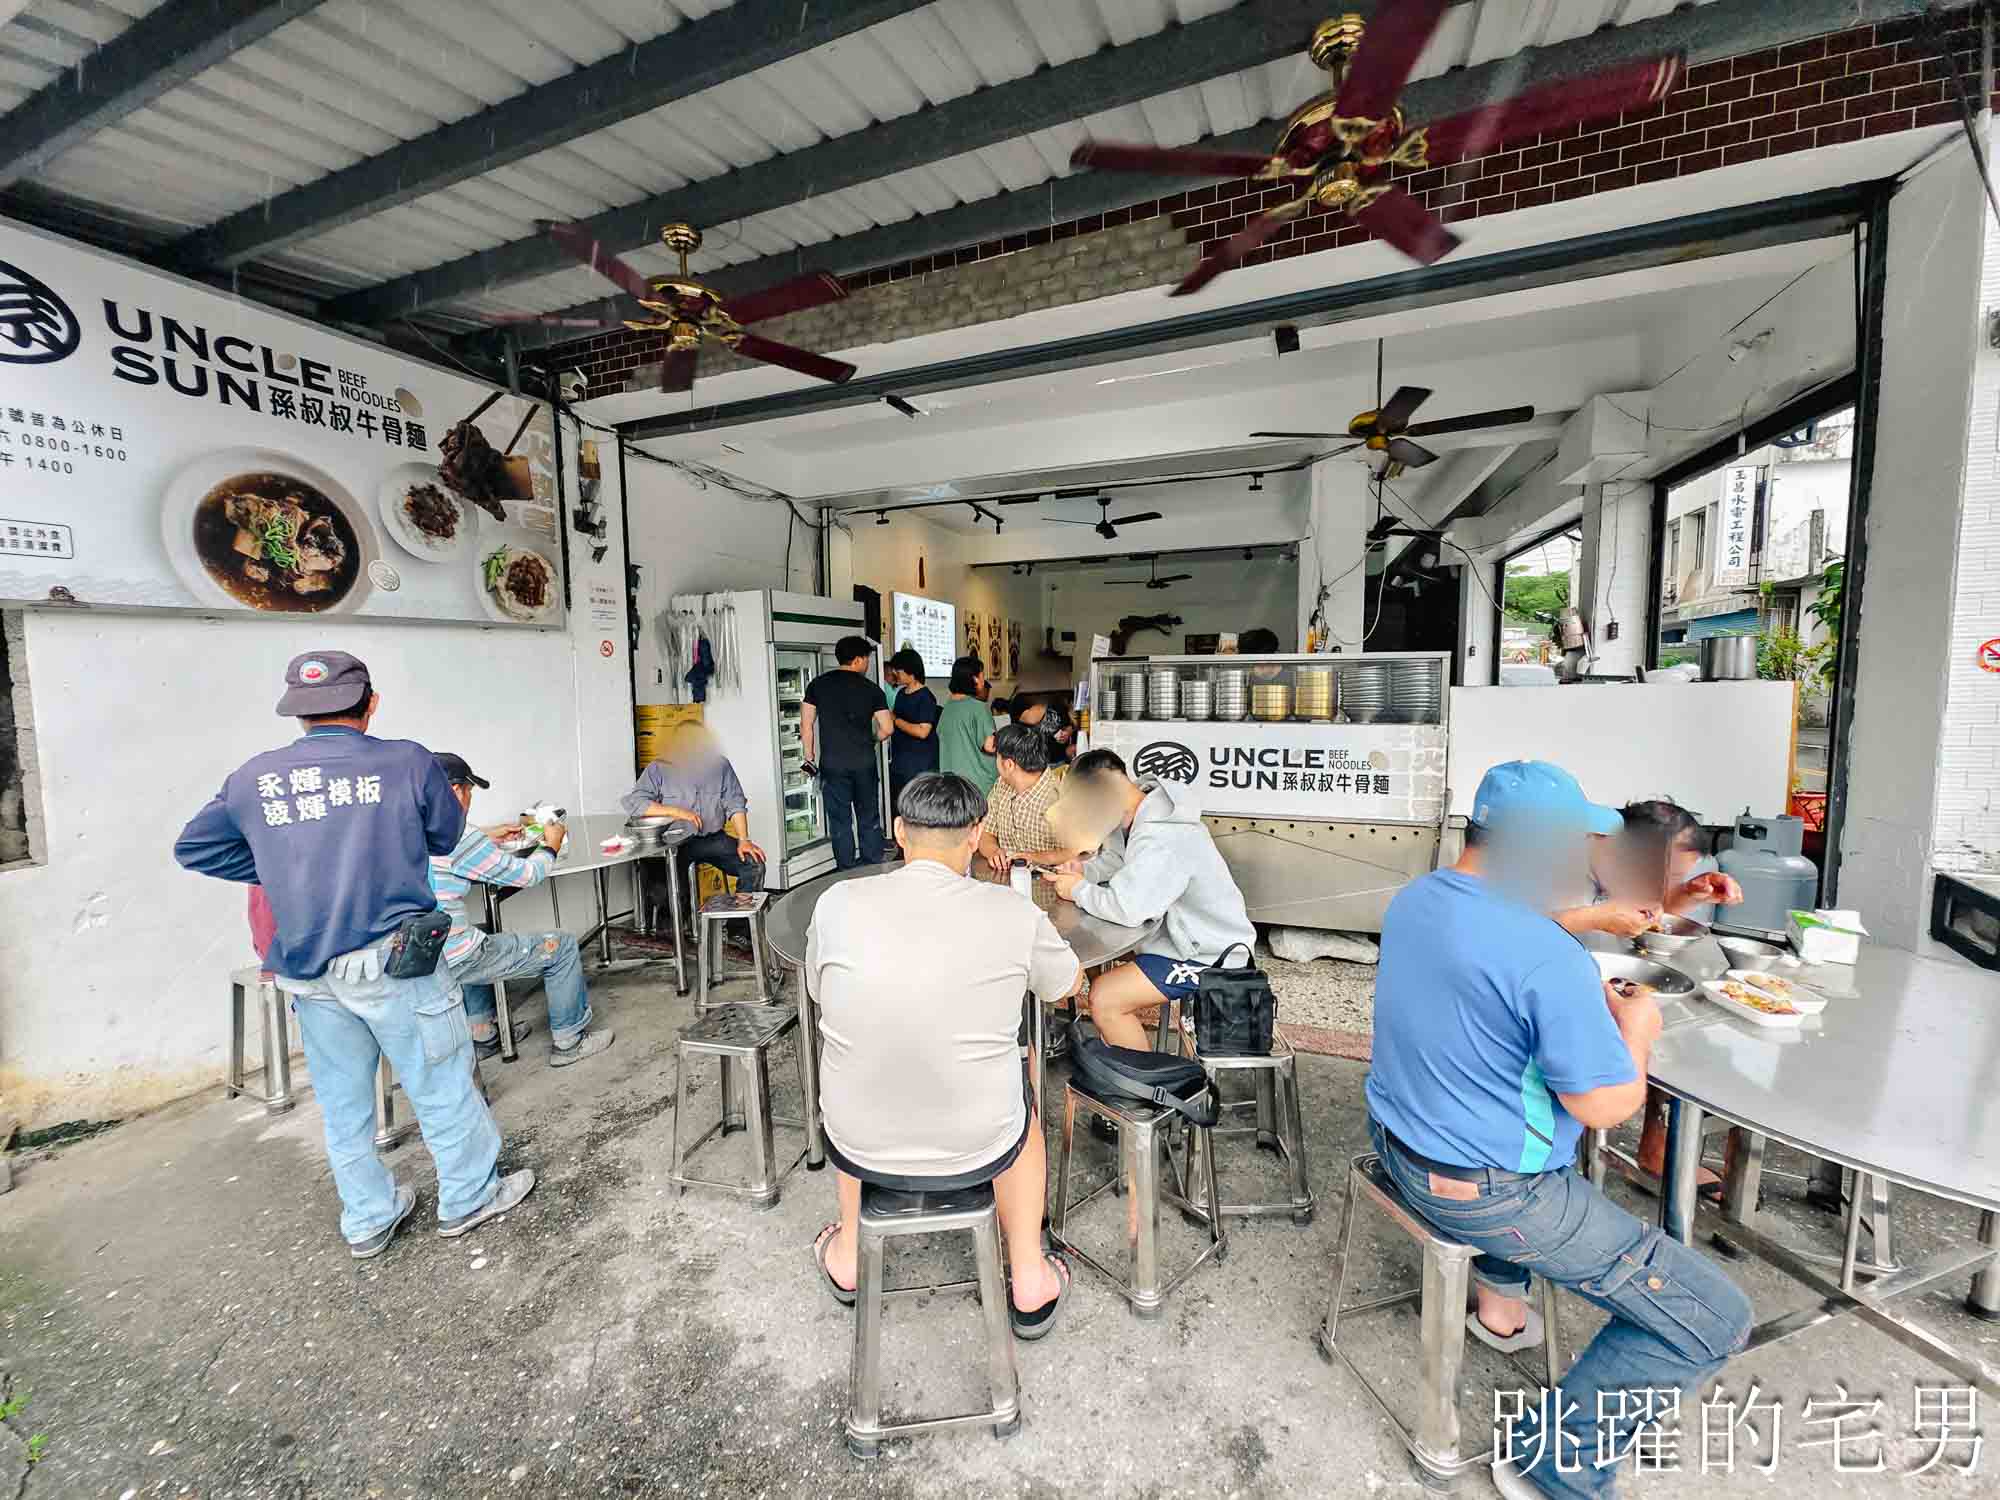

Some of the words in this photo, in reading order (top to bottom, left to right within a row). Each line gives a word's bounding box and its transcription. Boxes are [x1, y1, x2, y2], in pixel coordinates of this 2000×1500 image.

[103, 298, 335, 396] UNCLE
[111, 344, 263, 413] SUN
[337, 368, 368, 389] BEEF
[340, 383, 401, 413] NOODLES
[268, 385, 428, 452] 孫叔叔牛骨麵
[22, 433, 127, 462] 0800-1600
[26, 456, 73, 474] 1400
[1209, 746, 1325, 769] UNCLE
[1328, 749, 1349, 759] BEEF
[1328, 759, 1372, 770] NOODLES
[1209, 769, 1278, 790] SUN
[1282, 771, 1390, 795] 孫叔叔牛骨麵
